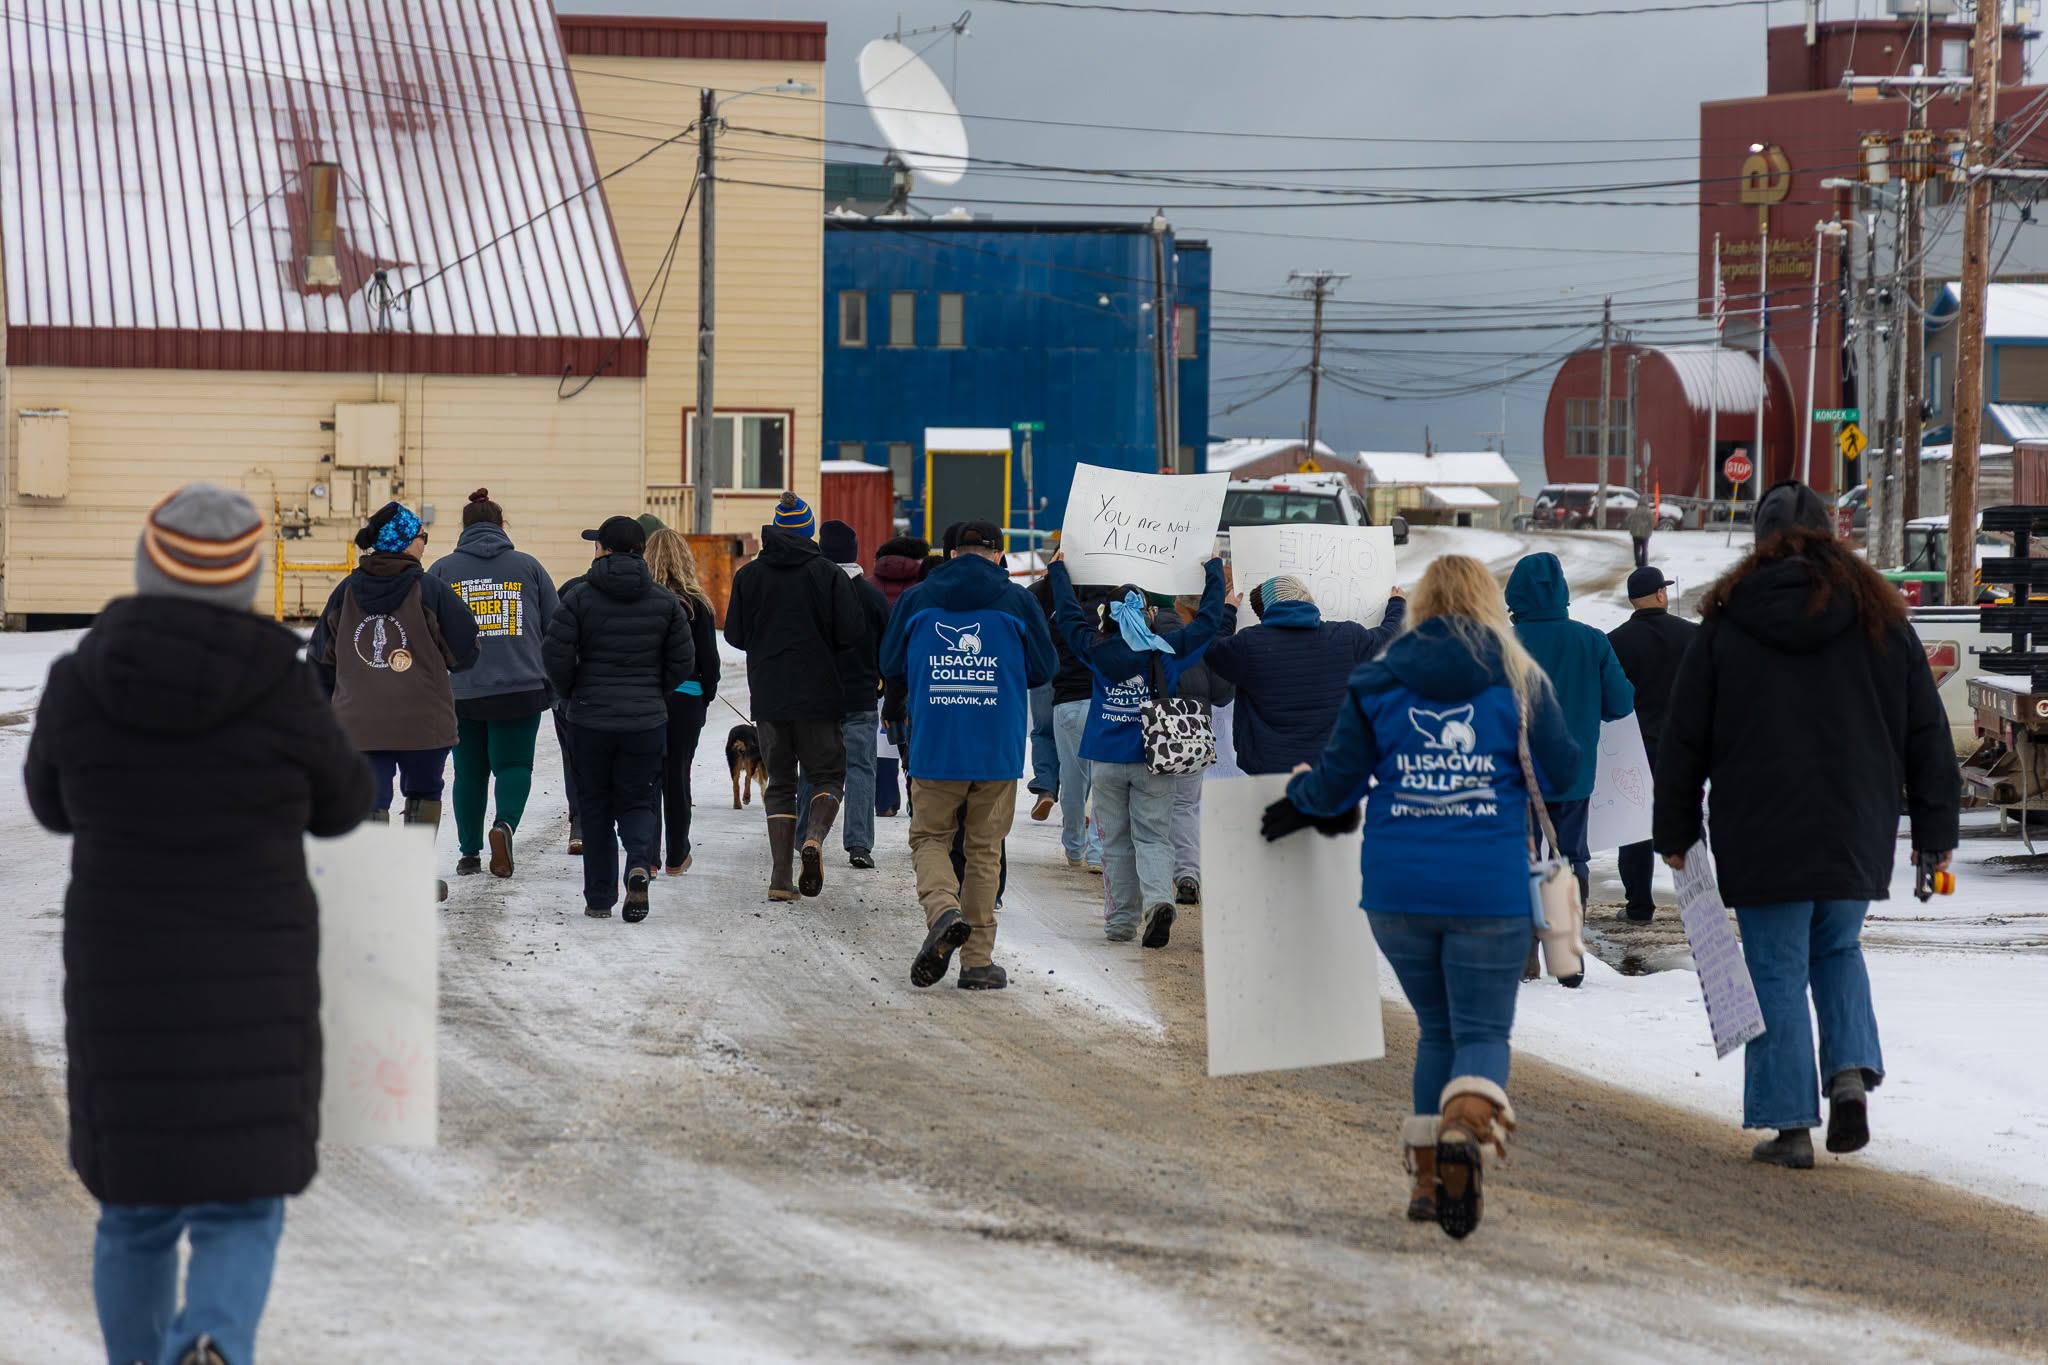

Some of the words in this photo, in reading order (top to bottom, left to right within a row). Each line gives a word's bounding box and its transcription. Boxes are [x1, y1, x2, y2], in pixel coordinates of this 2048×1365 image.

[1768, 257, 1813, 278] Building
[1727, 461, 1751, 475] STOP
[1167, 520, 1192, 533] Not
[468, 583, 503, 593] GIGACENTER
[503, 581, 522, 591] FAST
[493, 590, 521, 600] FUTURE
[469, 600, 502, 615] FIBER
[353, 622, 366, 642] NATIVE
[394, 620, 408, 647] BARROW
[931, 669, 995, 681] COLLEGE
[983, 697, 997, 706] AK
[1401, 773, 1493, 791] COLLEGE
[1474, 803, 1498, 816] AK
